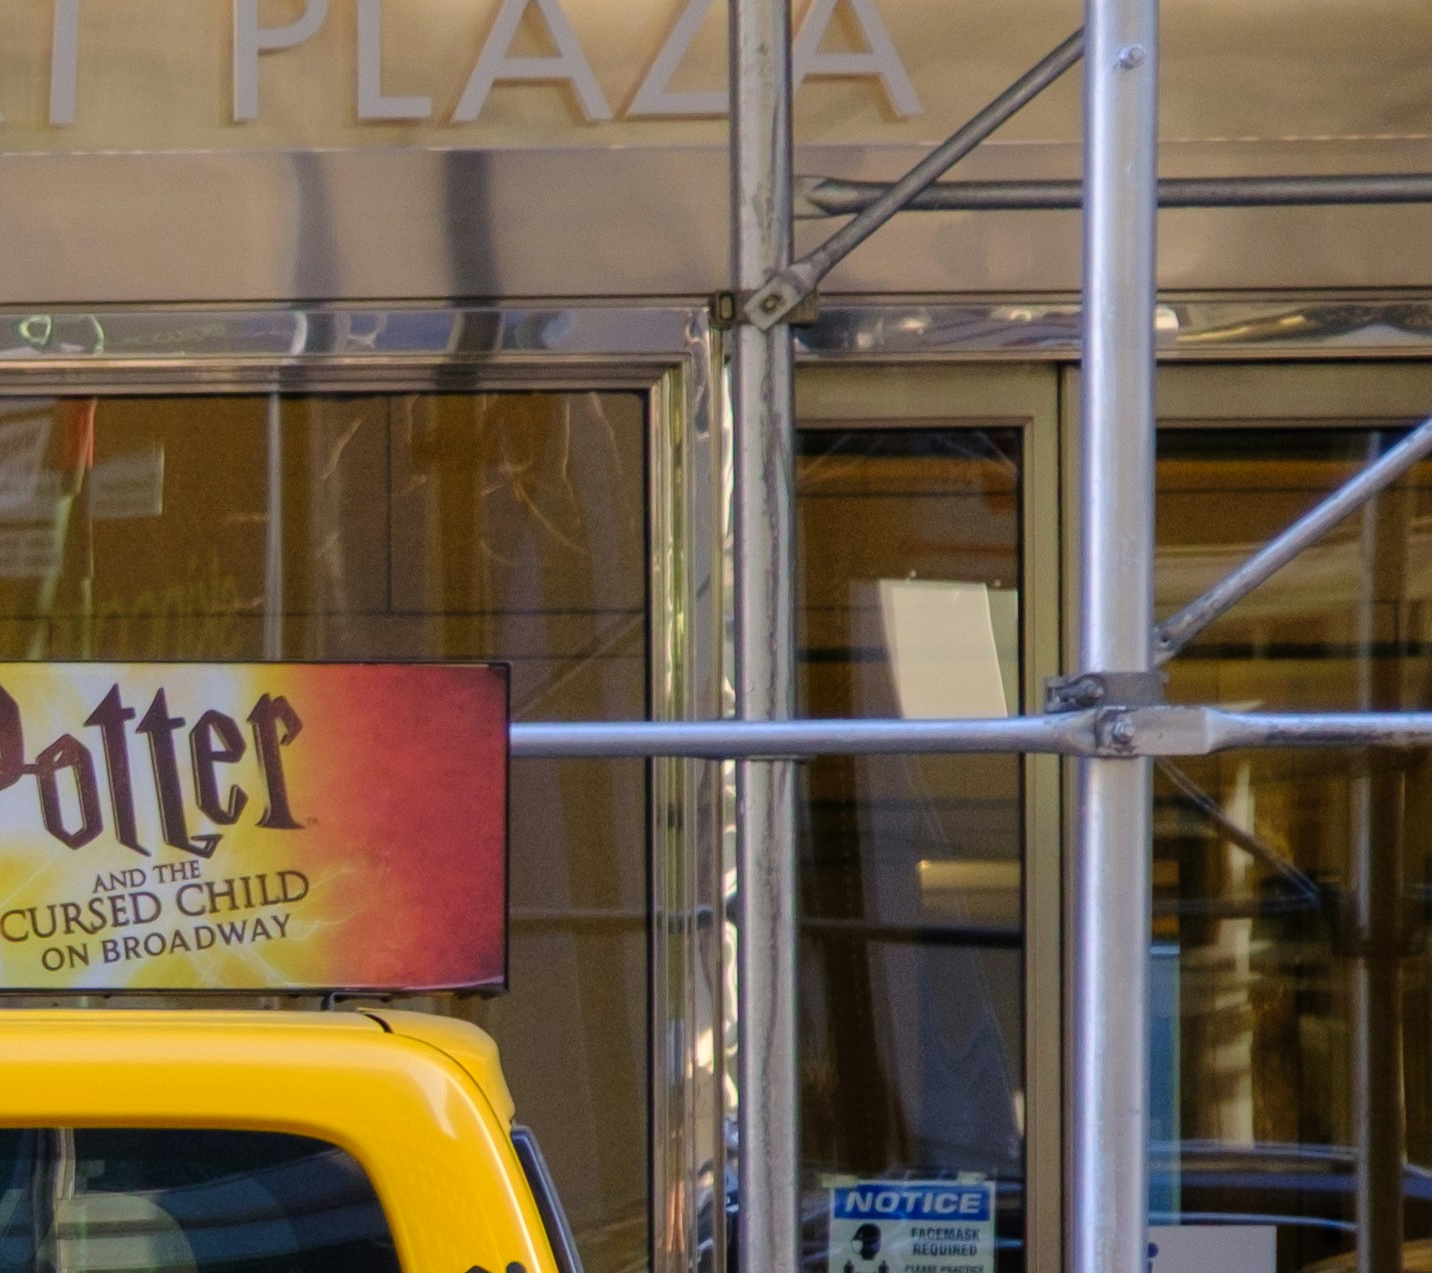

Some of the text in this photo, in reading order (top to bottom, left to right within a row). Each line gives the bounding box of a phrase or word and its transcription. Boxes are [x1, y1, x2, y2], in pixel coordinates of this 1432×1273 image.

[92, 860, 201, 894] AND THE
[0, 870, 310, 942] CURSED CHILD
[41, 914, 291, 971] ON BROADWAY
[845, 1191, 982, 1214] NOTICE
[911, 1227, 980, 1241] FACEMASK
[912, 1243, 978, 1257] REQUIRED
